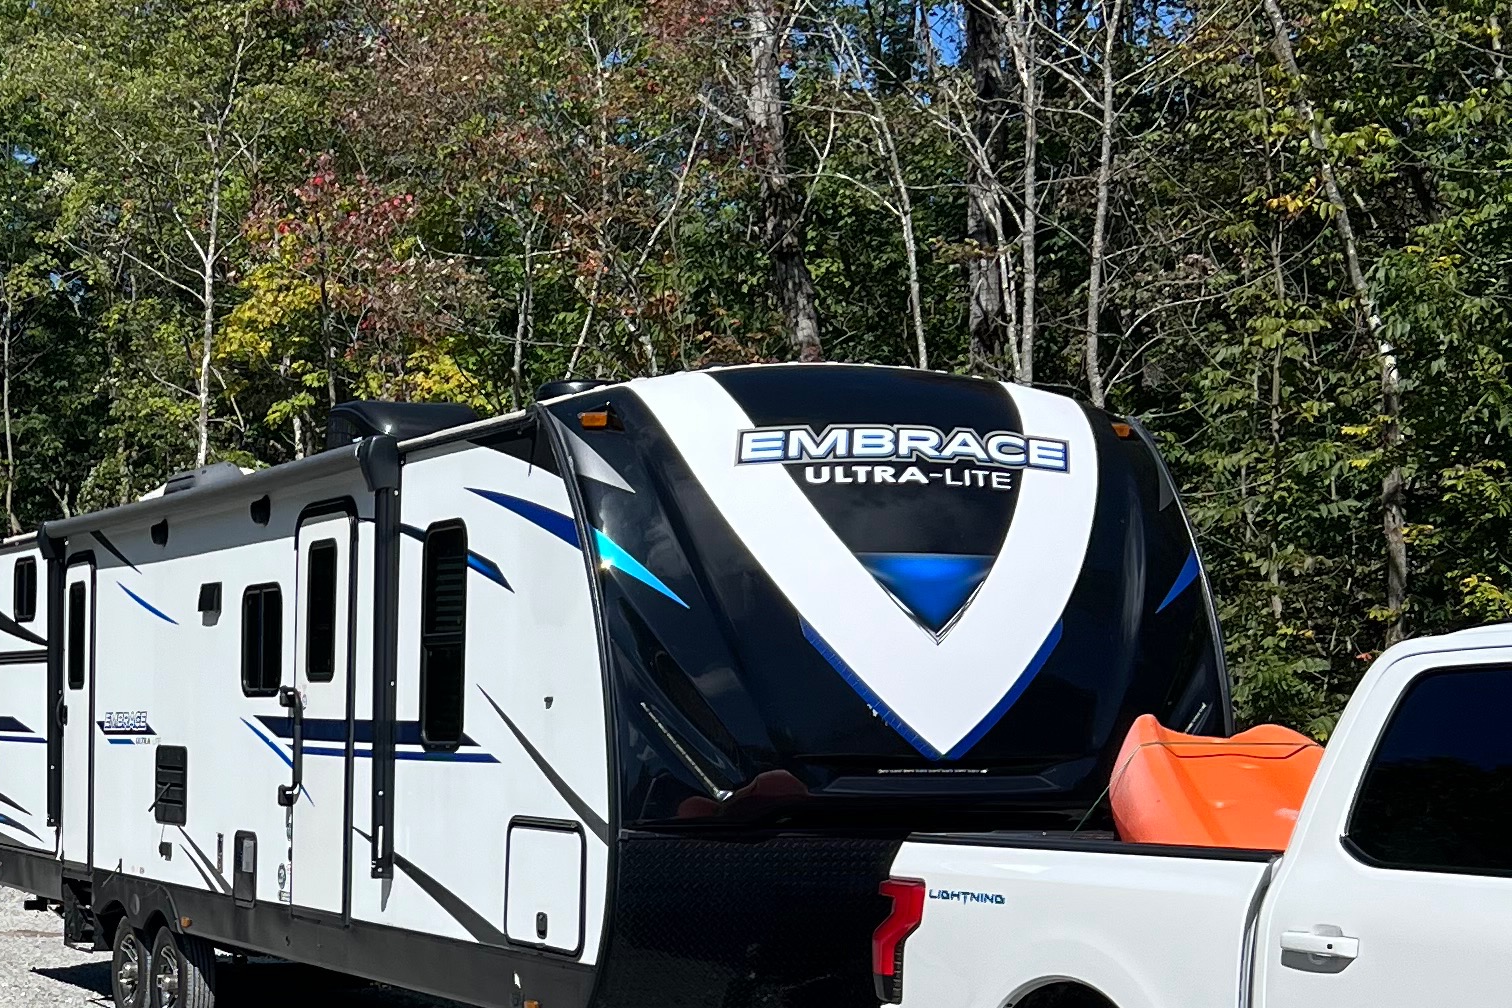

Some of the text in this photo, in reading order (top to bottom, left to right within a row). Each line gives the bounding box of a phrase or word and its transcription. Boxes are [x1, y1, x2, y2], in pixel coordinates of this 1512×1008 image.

[740, 427, 1068, 469] EMBRACE
[804, 465, 1012, 490] ULTRA-LITE
[929, 889, 1005, 904] LIGHTNING
